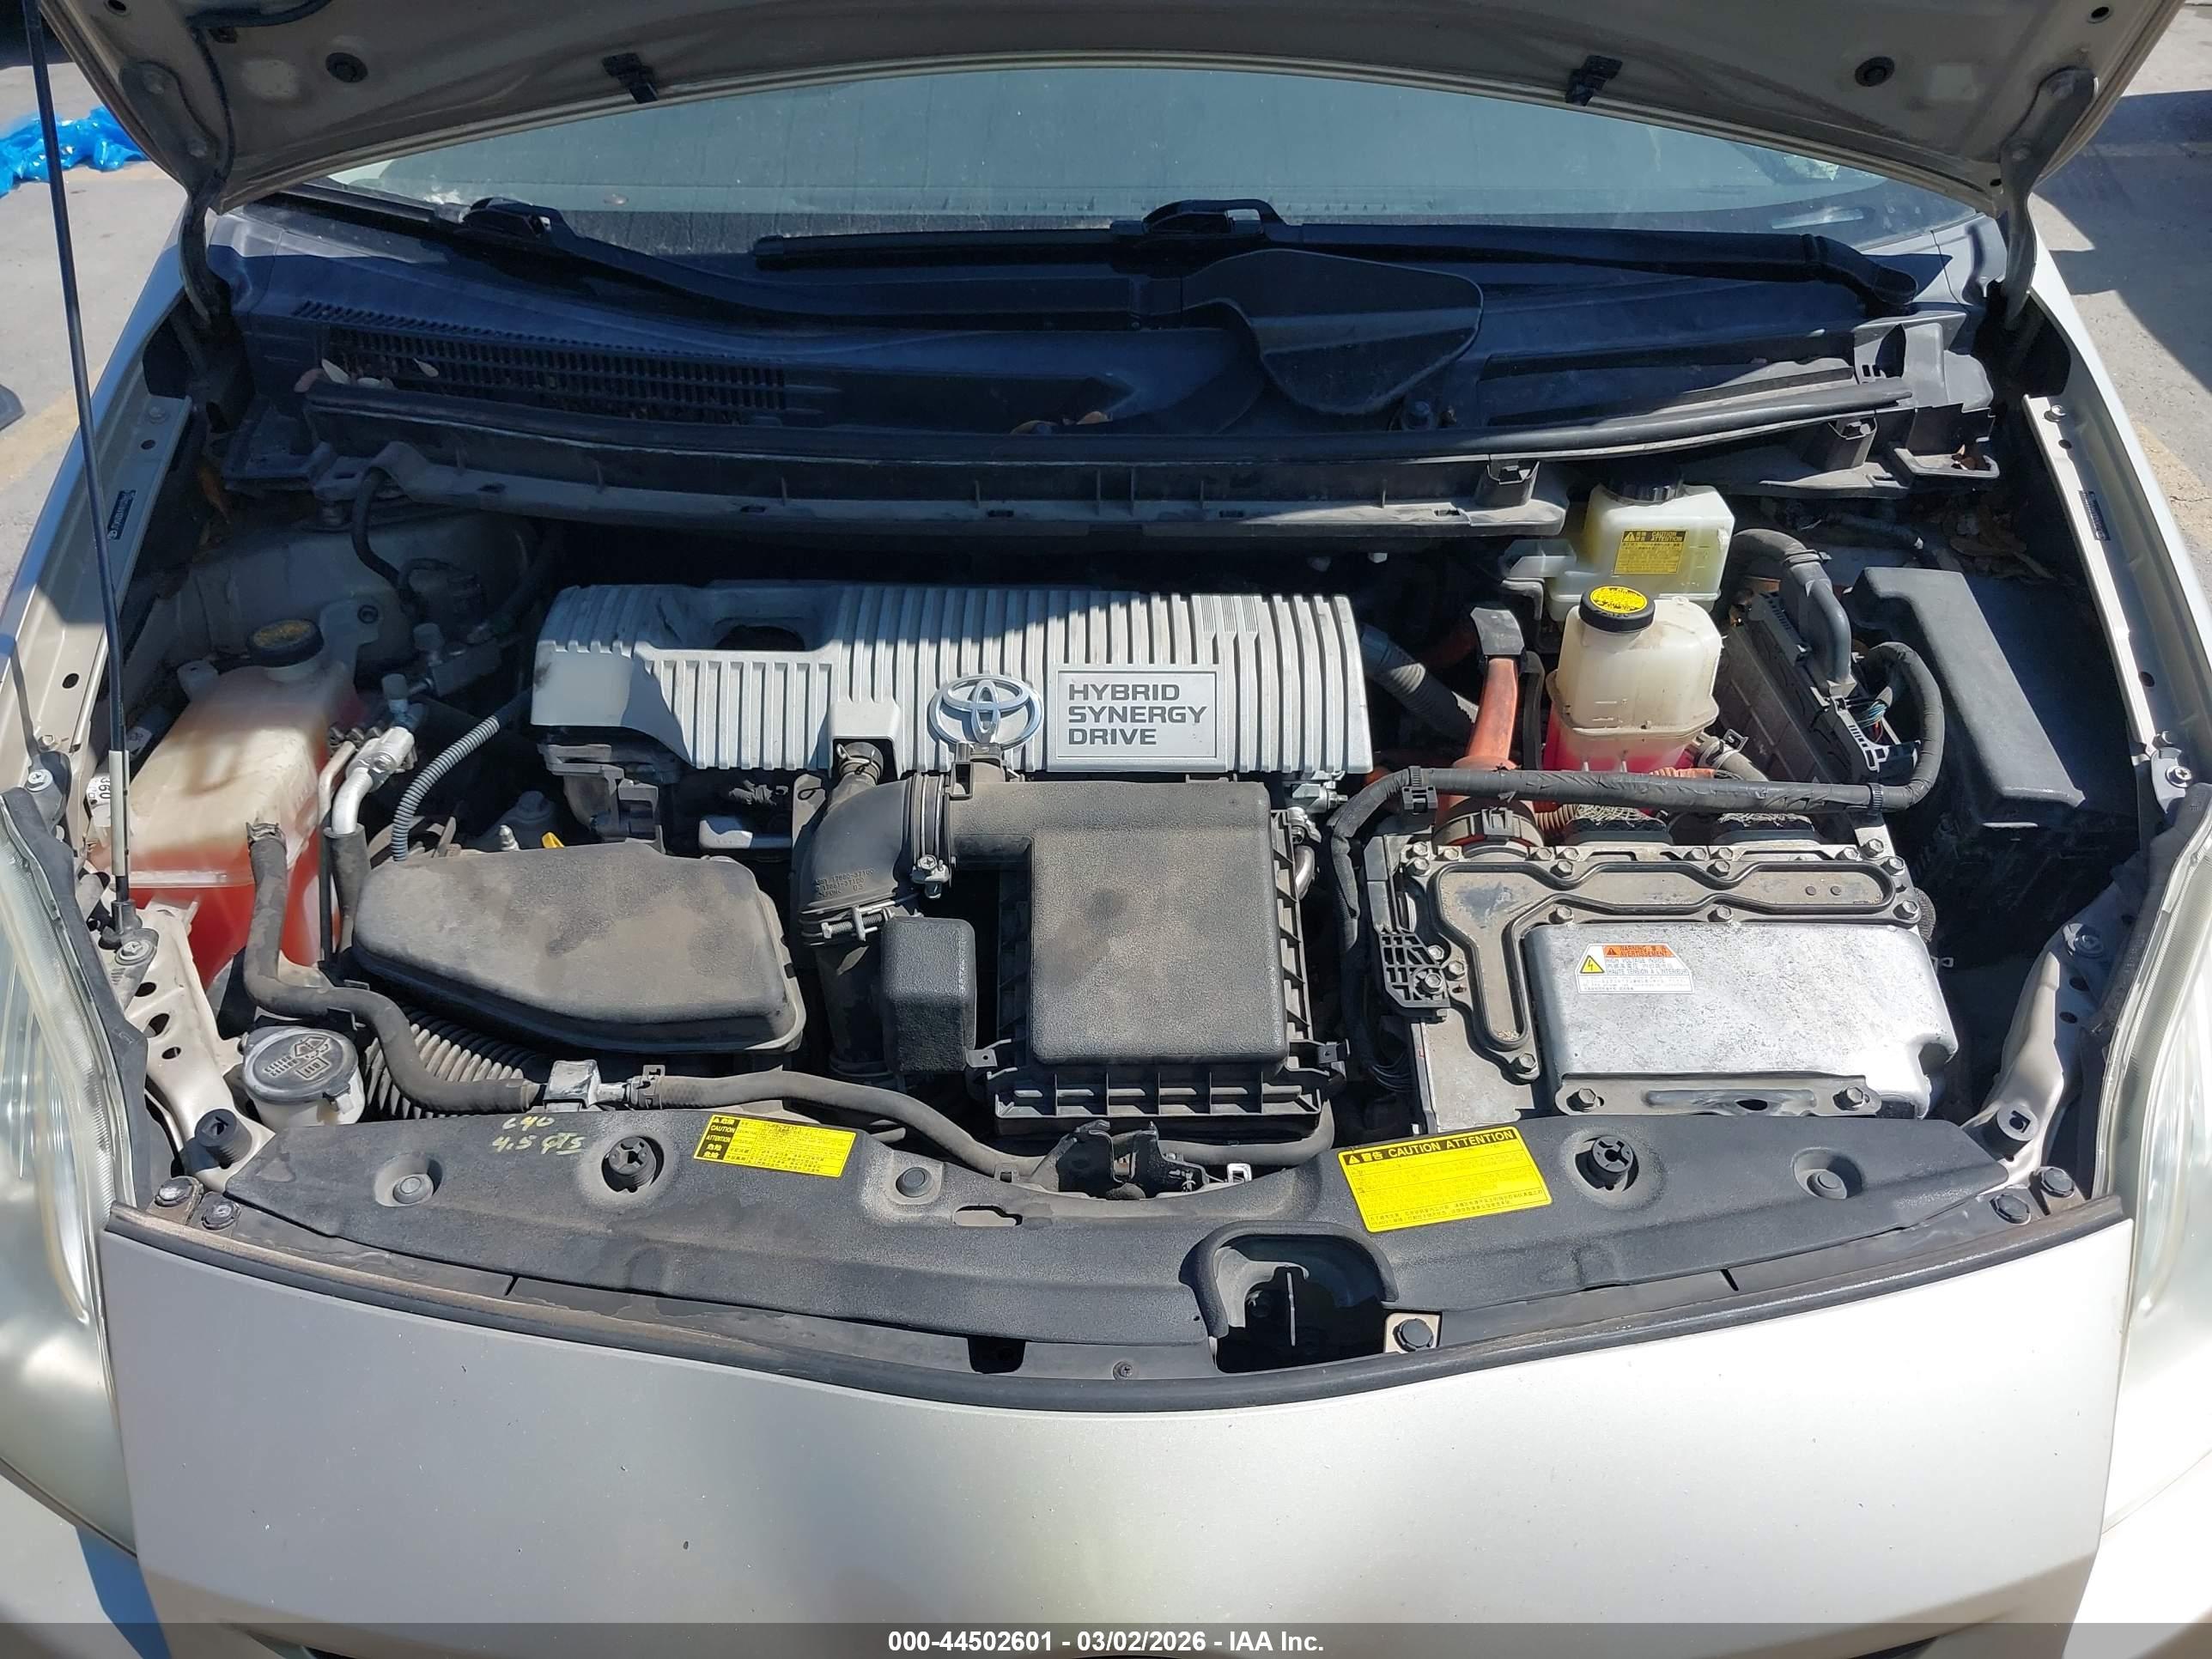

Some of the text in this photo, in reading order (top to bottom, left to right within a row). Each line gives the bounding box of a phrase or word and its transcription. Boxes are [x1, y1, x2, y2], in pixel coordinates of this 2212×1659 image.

[1068, 684, 1180, 701] HYBRID
[1068, 706, 1207, 723] SYNERGY
[1068, 728, 1157, 745] DRIVE
[710, 1125, 736, 1133] CAUTION
[705, 1133, 731, 1143] ATTENTION
[1388, 1141, 1442, 1158] CAUTION
[1446, 1130, 1514, 1150] ATTENTION
